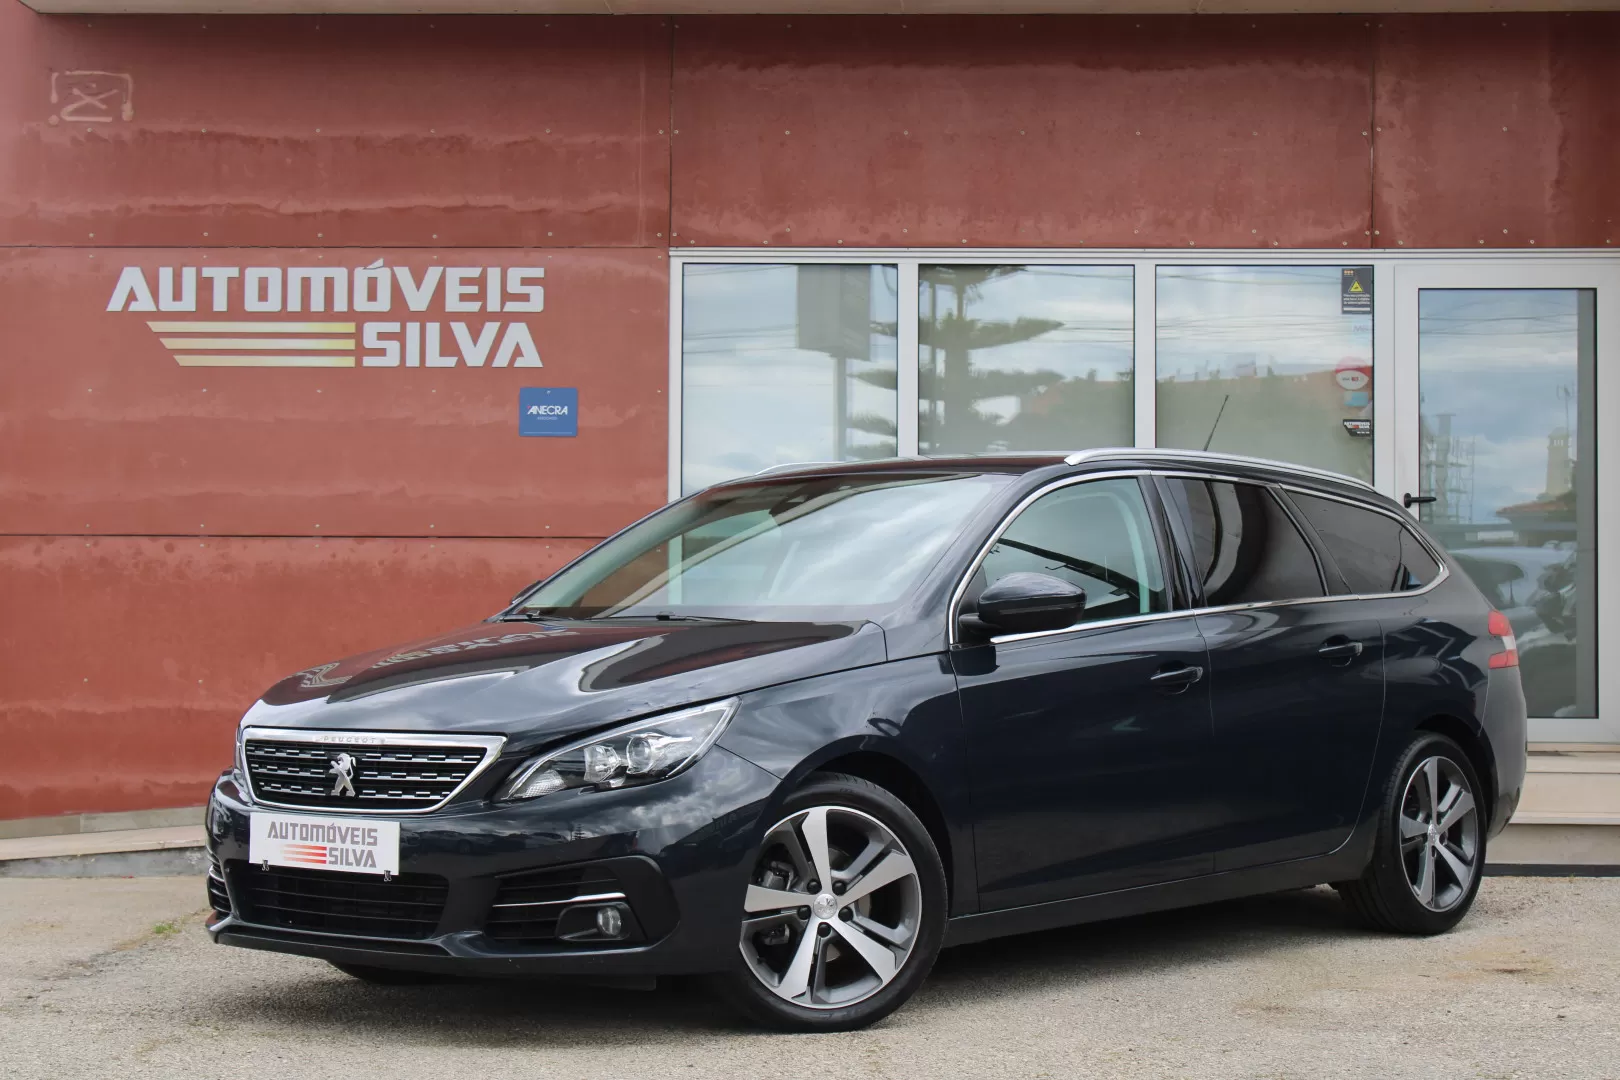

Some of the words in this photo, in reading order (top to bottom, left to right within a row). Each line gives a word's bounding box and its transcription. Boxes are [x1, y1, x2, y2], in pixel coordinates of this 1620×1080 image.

[106, 258, 545, 312] AUTOMÓVEIS
[362, 322, 544, 368] SILVA
[527, 405, 568, 415] ANECRA
[323, 736, 377, 744] PEUGEOT
[267, 821, 378, 846] AUTOMÓVEIS
[328, 847, 377, 868] SILVA
